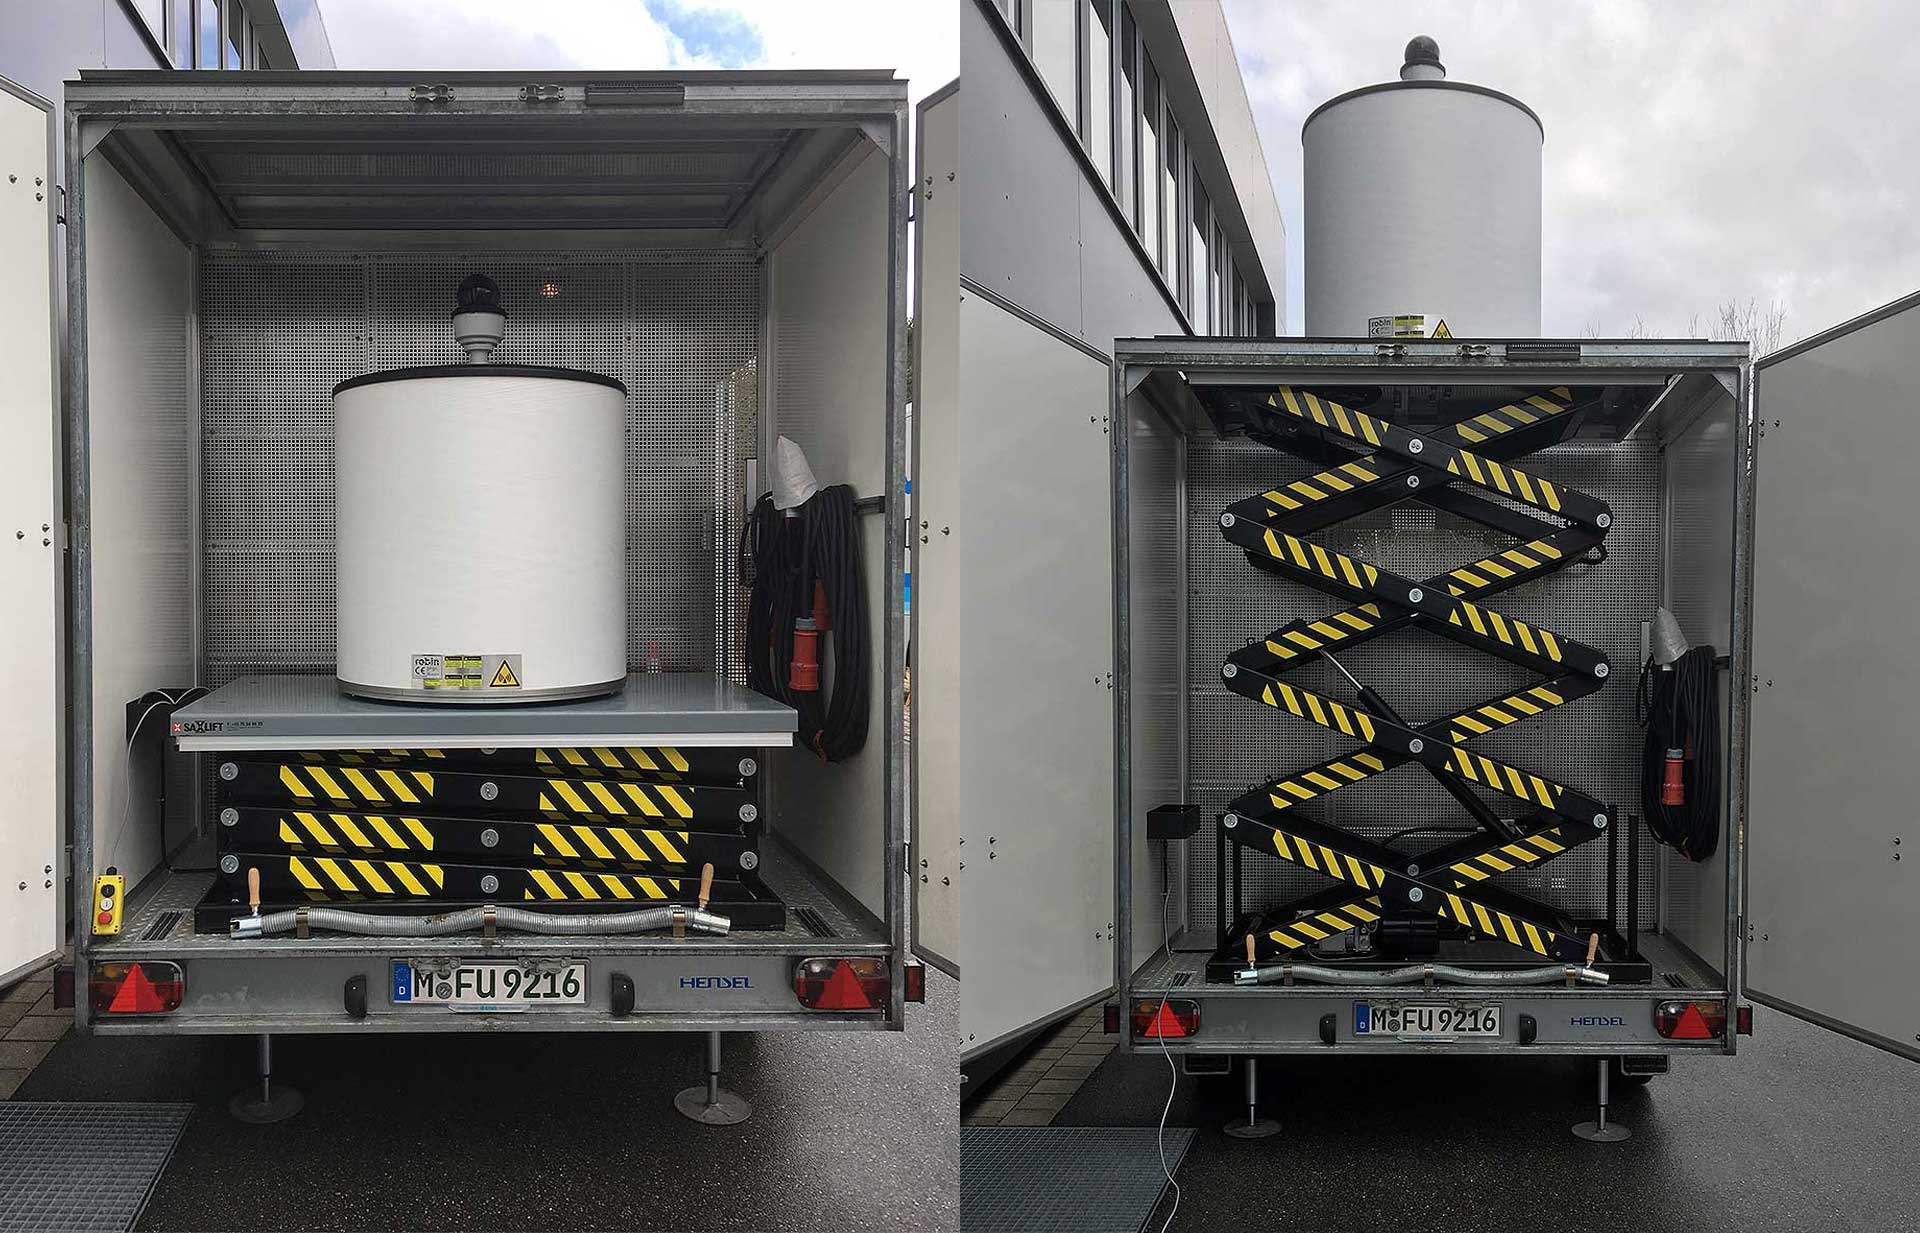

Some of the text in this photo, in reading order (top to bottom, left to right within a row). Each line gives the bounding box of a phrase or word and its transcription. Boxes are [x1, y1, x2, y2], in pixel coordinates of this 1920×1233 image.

[1371, 319, 1391, 327] robin
[415, 657, 440, 666] robin
[414, 666, 426, 675] CE
[183, 720, 224, 733] SAXLIFT
[414, 966, 580, 999] M FU 9216
[680, 976, 753, 989] HENSEL
[398, 986, 406, 995] D
[1371, 1008, 1497, 1032] M FU 9216
[1571, 1016, 1627, 1026] HENSEL
[1359, 1022, 1366, 1030] D
